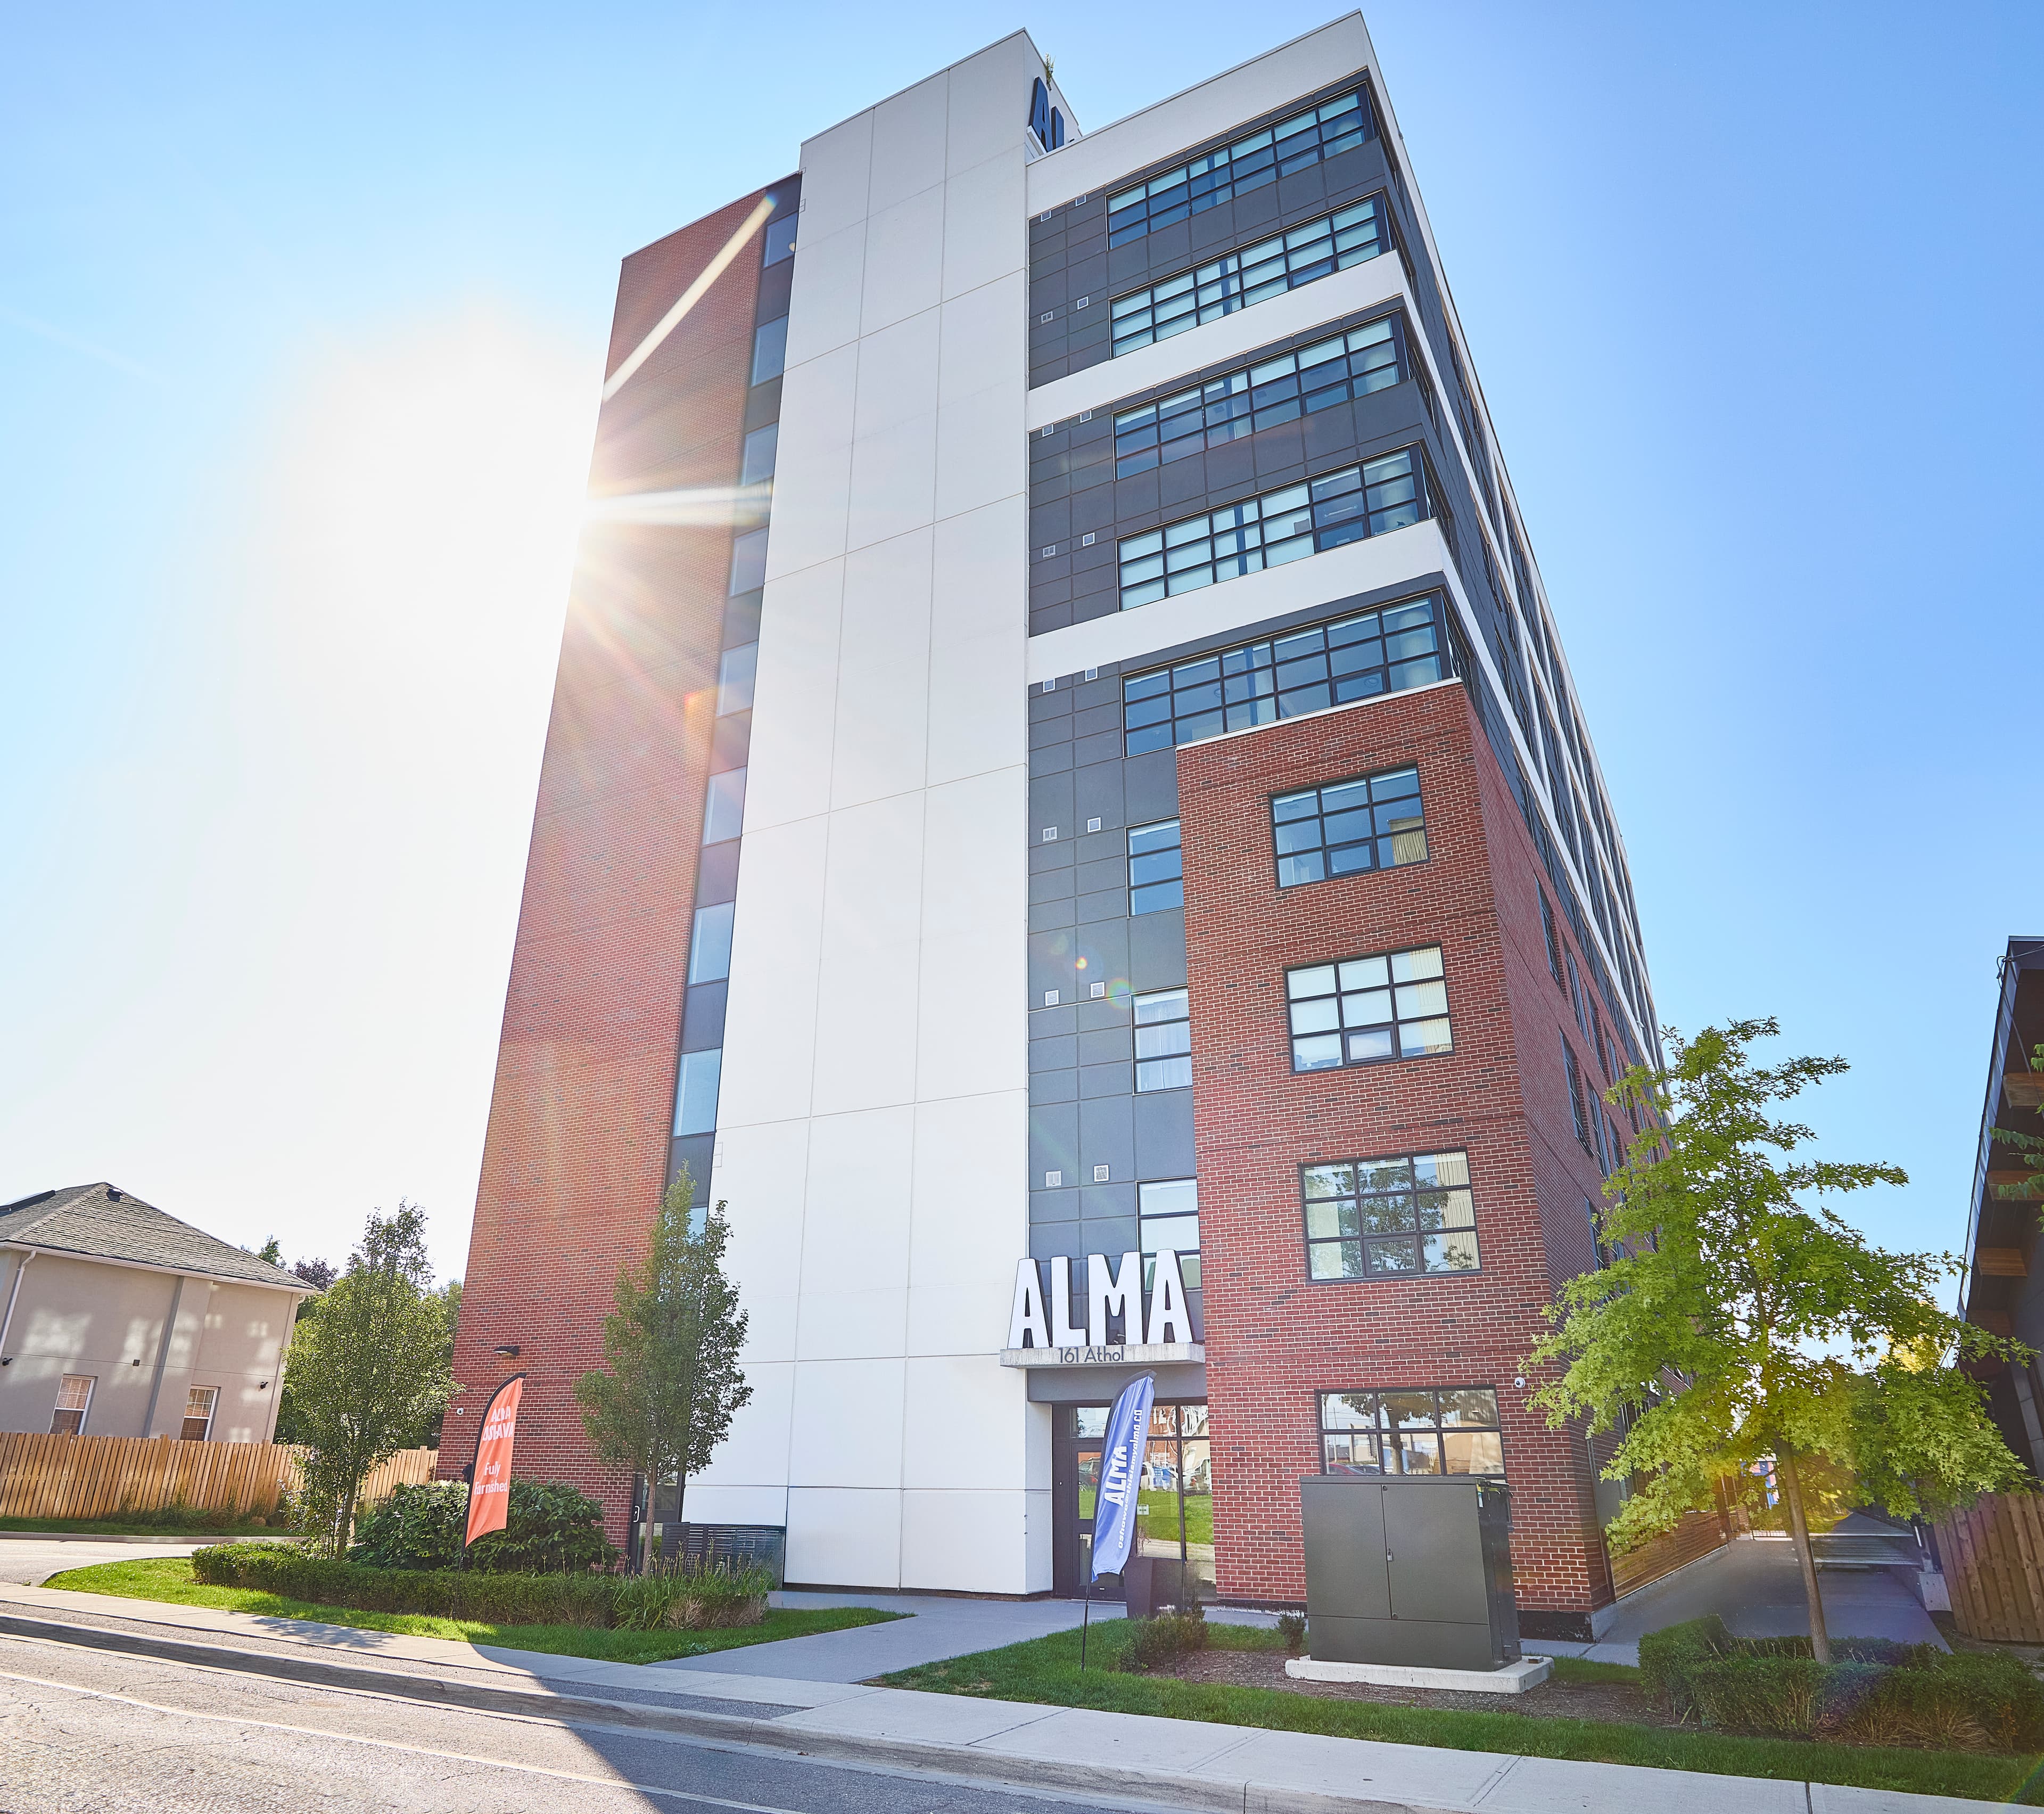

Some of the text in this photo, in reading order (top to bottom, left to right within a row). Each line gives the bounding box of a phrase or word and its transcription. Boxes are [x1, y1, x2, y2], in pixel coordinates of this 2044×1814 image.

[1007, 1249, 1194, 1349] ALMA
[1058, 1345, 1124, 1364] 161 Athol
[1104, 1446, 1127, 1507] ALMA
